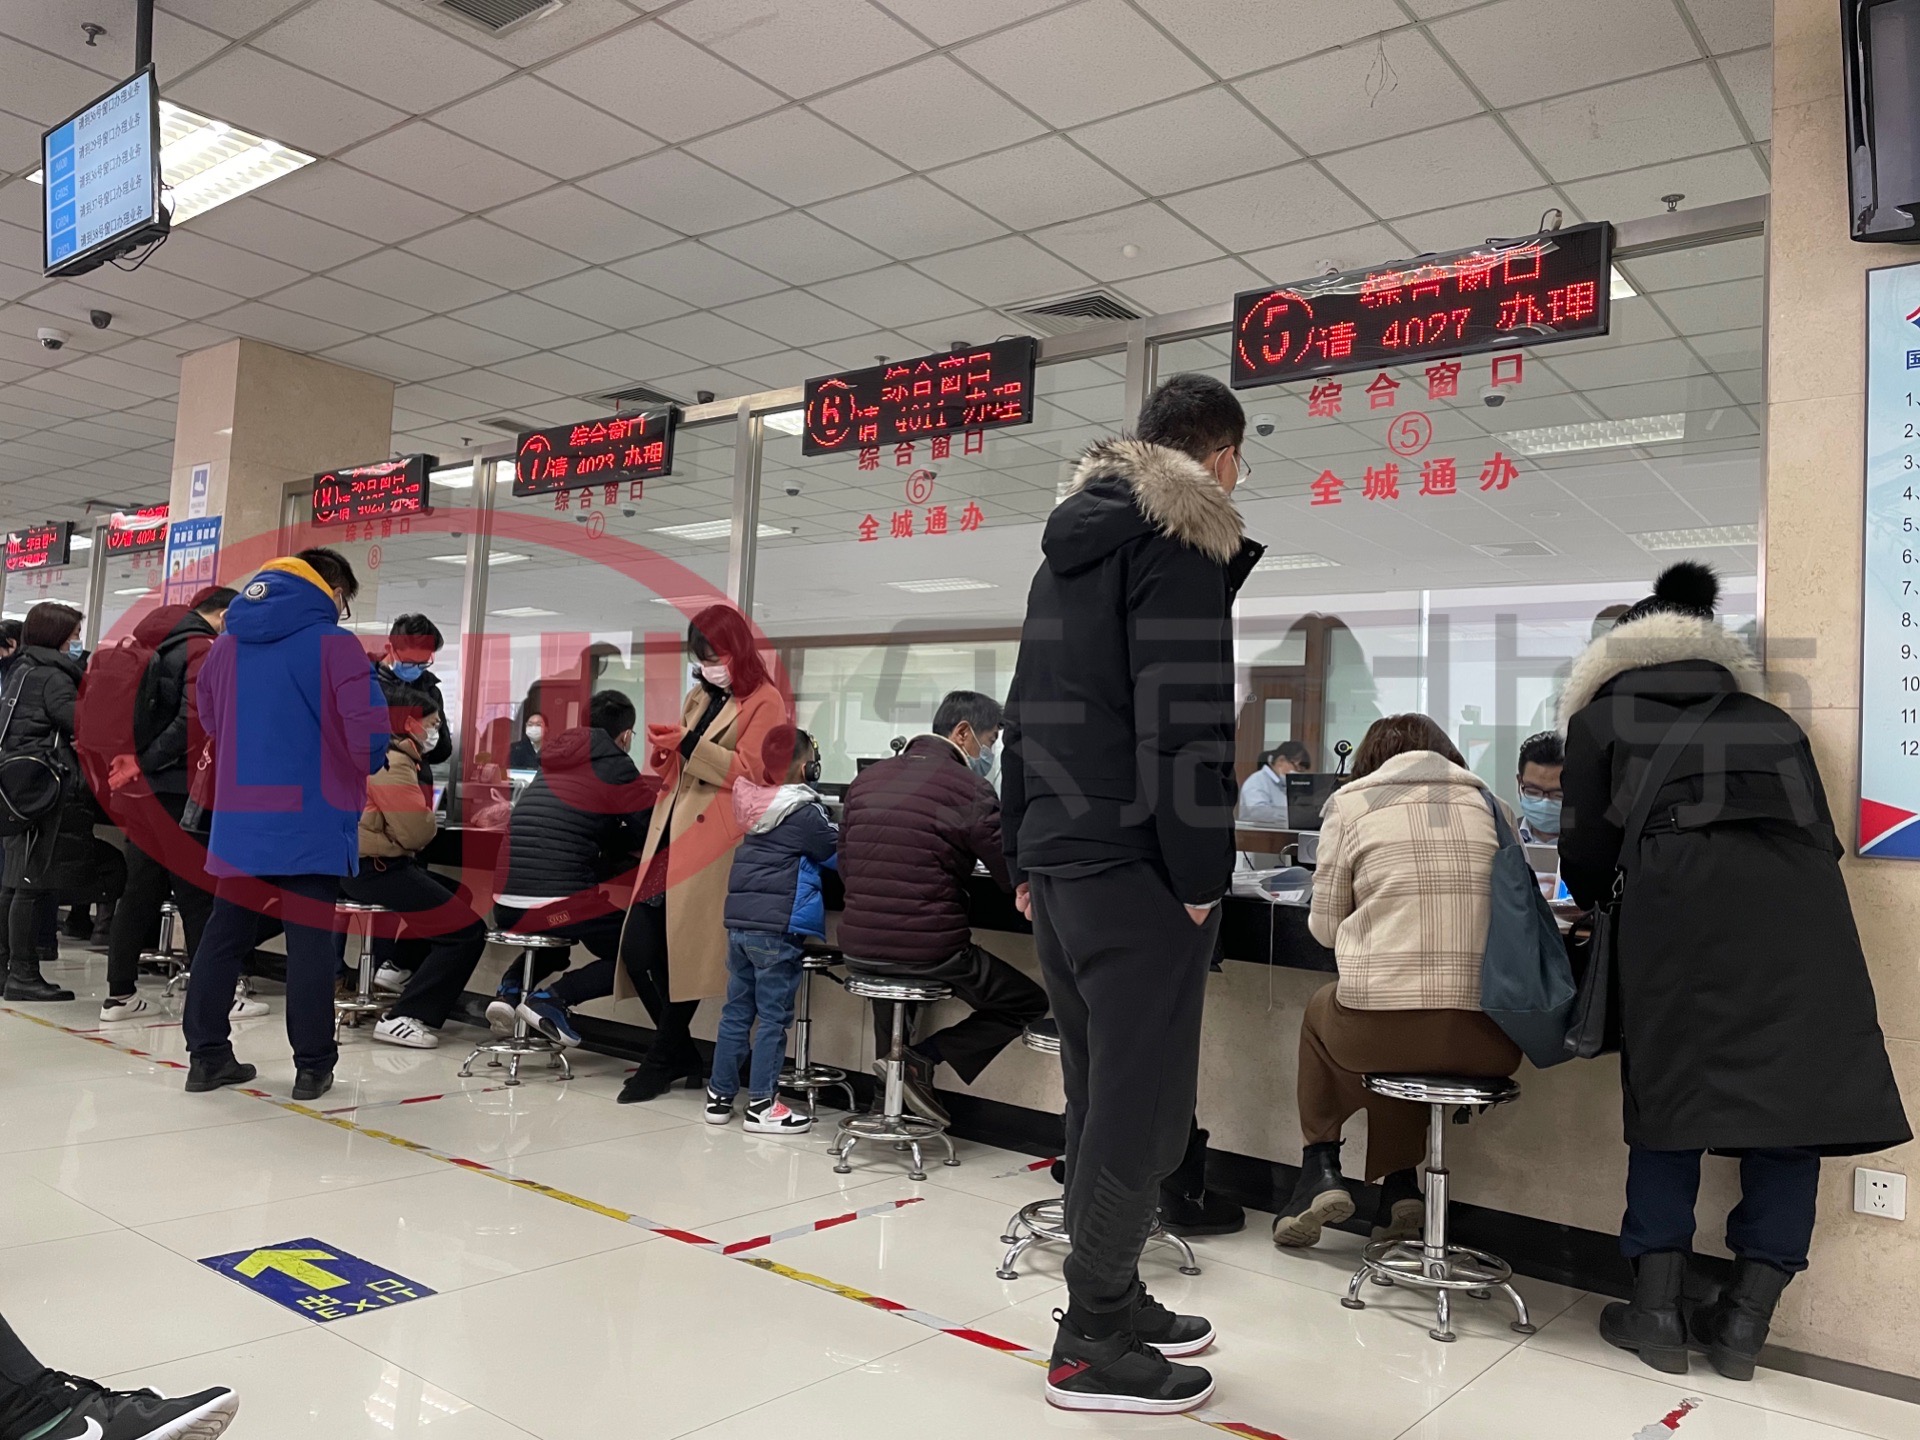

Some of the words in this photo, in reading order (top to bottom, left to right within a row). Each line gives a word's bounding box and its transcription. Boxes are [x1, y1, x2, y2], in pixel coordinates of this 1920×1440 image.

[1316, 321, 1357, 359] 请
[1496, 280, 1595, 331] 办理
[1308, 353, 1524, 418] 综合窗口
[623, 441, 663, 471] 办理
[858, 430, 984, 472] 综合窗口
[554, 480, 644, 512] 综合窗口
[1310, 452, 1518, 506] 全城通办
[858, 501, 984, 542] 全城通办
[296, 1278, 405, 1311] 出口
[314, 1287, 418, 1319] EXIT
